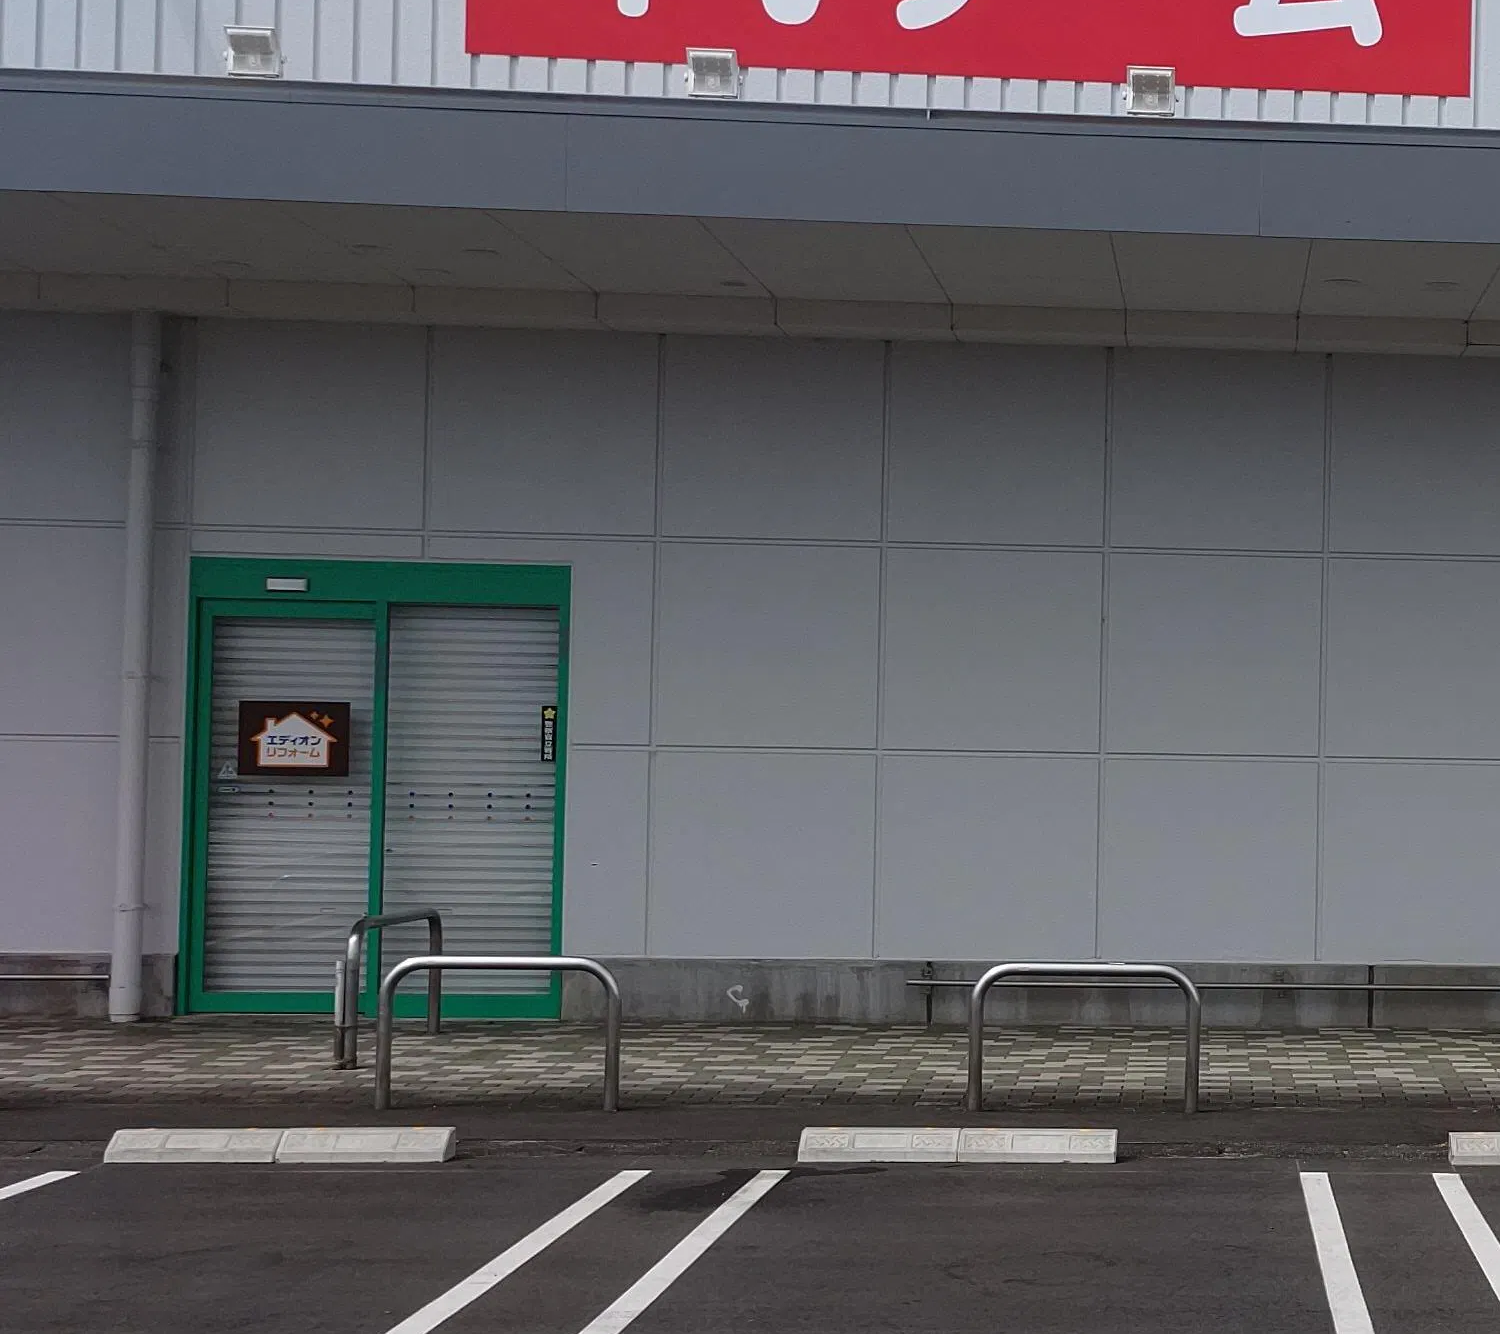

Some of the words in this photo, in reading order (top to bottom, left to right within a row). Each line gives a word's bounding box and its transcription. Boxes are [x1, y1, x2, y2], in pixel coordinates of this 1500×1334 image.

[267, 735, 322, 746] エディオン
[267, 747, 321, 758] リフォーム
